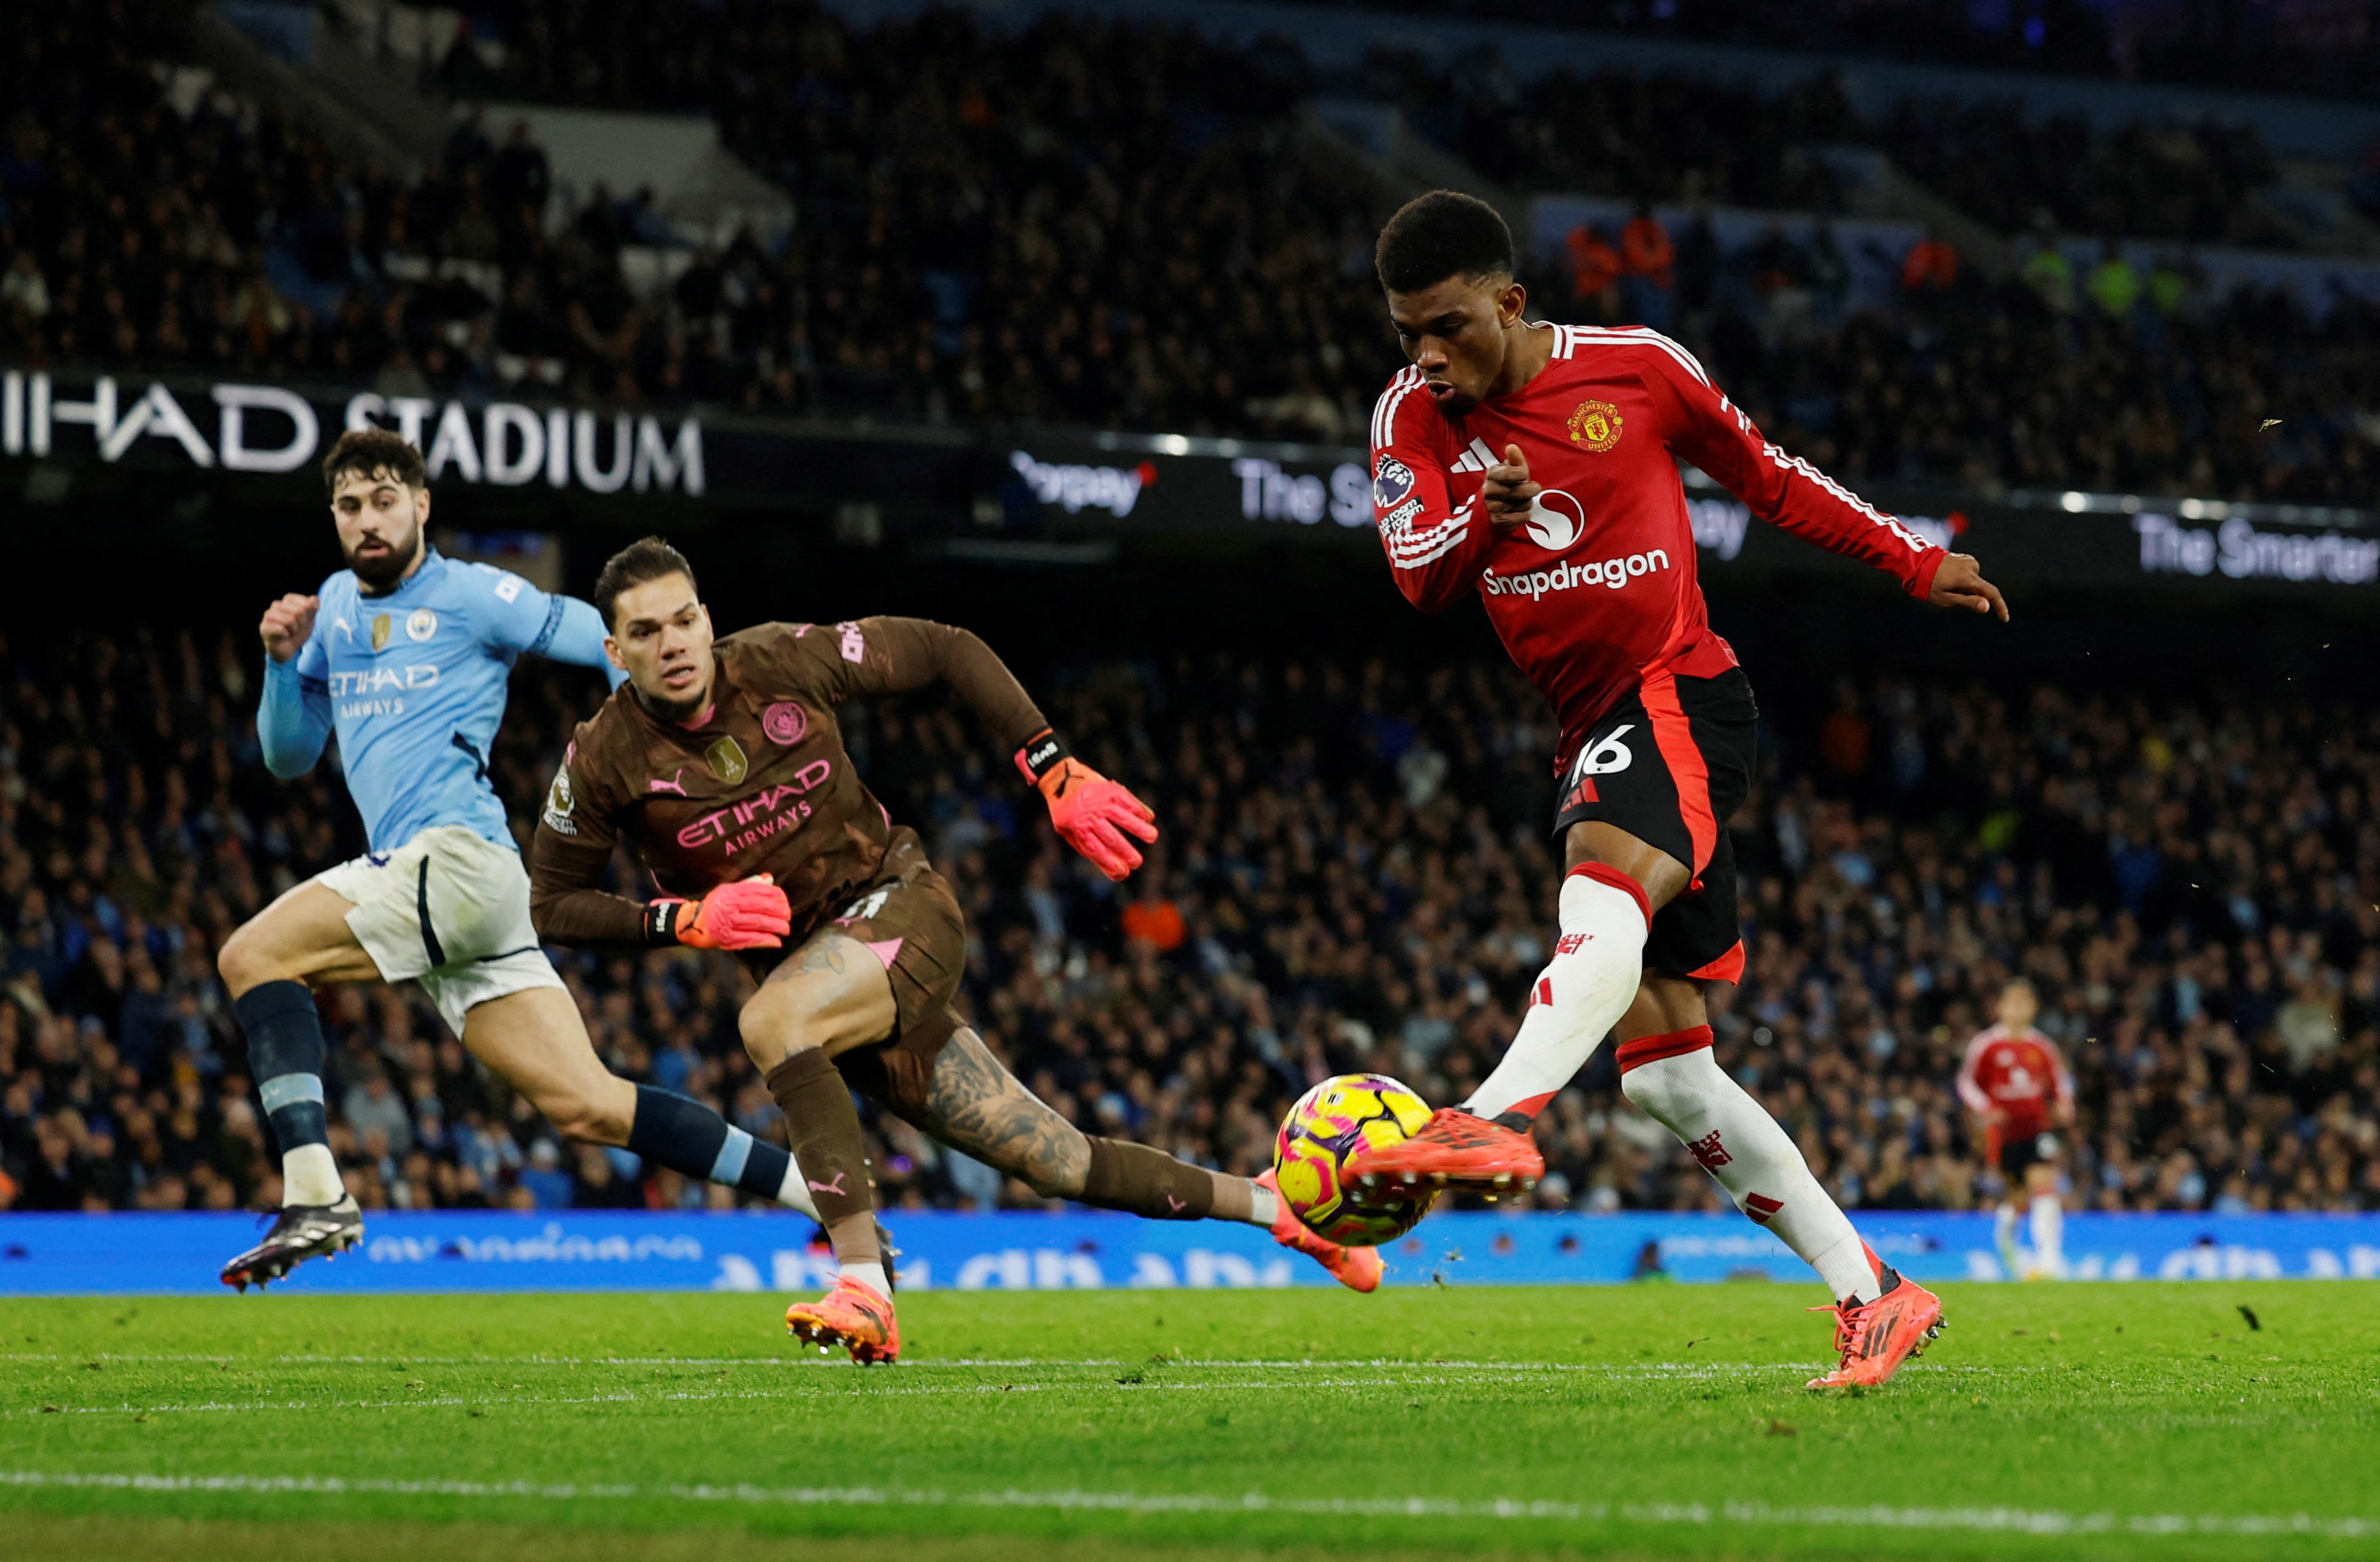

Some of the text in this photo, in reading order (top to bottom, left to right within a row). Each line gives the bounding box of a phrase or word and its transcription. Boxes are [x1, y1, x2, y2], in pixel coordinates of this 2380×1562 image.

[1572, 404, 1613, 428] MANCHESTER
[1588, 435, 1617, 449] UNITED
[344, 392, 706, 498] STADIUM
[1482, 549, 1670, 601] Snapdragon
[1570, 724, 1635, 789] 16
[676, 759, 831, 849] ETIHAD
[725, 800, 812, 856] AIRWAYS
